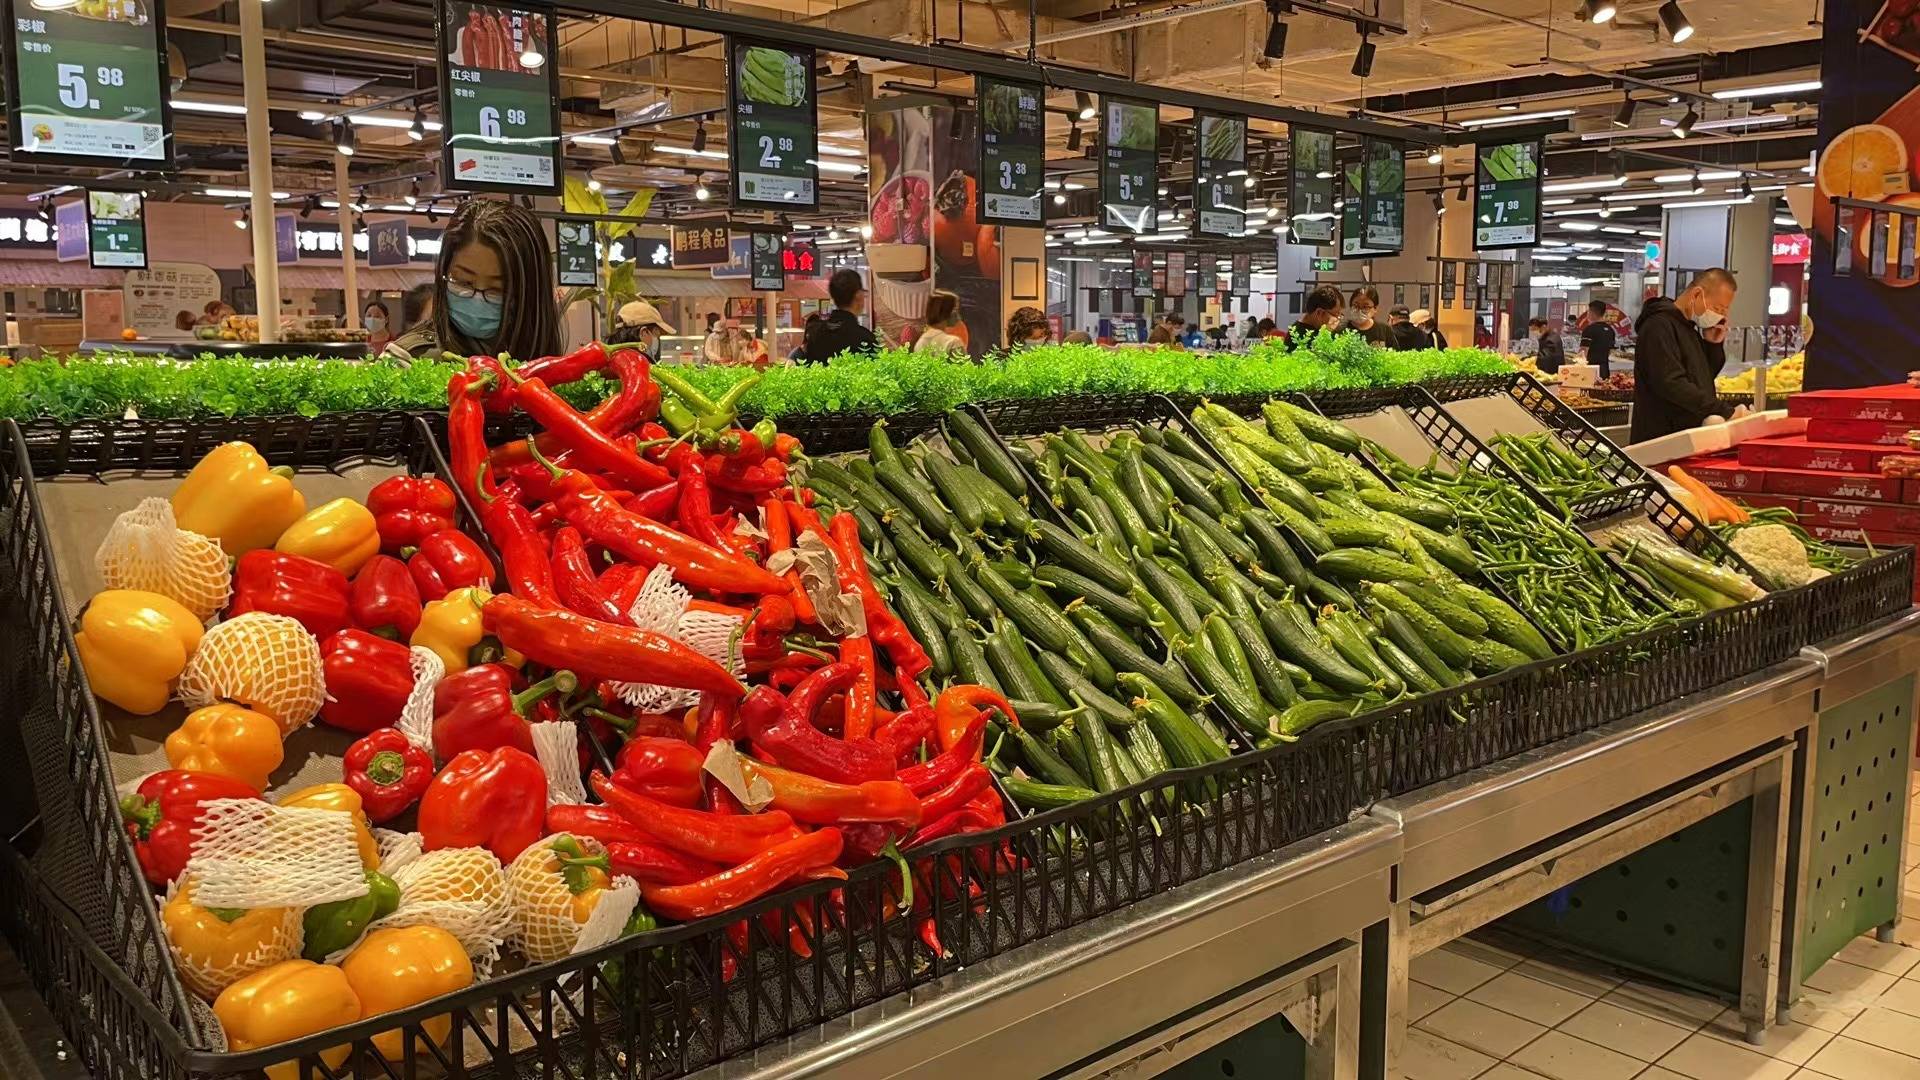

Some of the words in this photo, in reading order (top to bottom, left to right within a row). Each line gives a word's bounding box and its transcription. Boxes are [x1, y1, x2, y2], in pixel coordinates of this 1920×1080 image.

[17, 18, 47, 34] 彩椒
[22, 41, 53, 54] 零售价
[450, 69, 481, 83] 红尖椒
[57, 63, 124, 110] 5.98
[454, 88, 476, 99] 零售价
[737, 103, 753, 114] 尖椒
[758, 135, 794, 169] 2.98
[999, 161, 1027, 190] 3.38
[1494, 200, 1520, 224] 7.98
[675, 228, 727, 252] 鹏程食品
